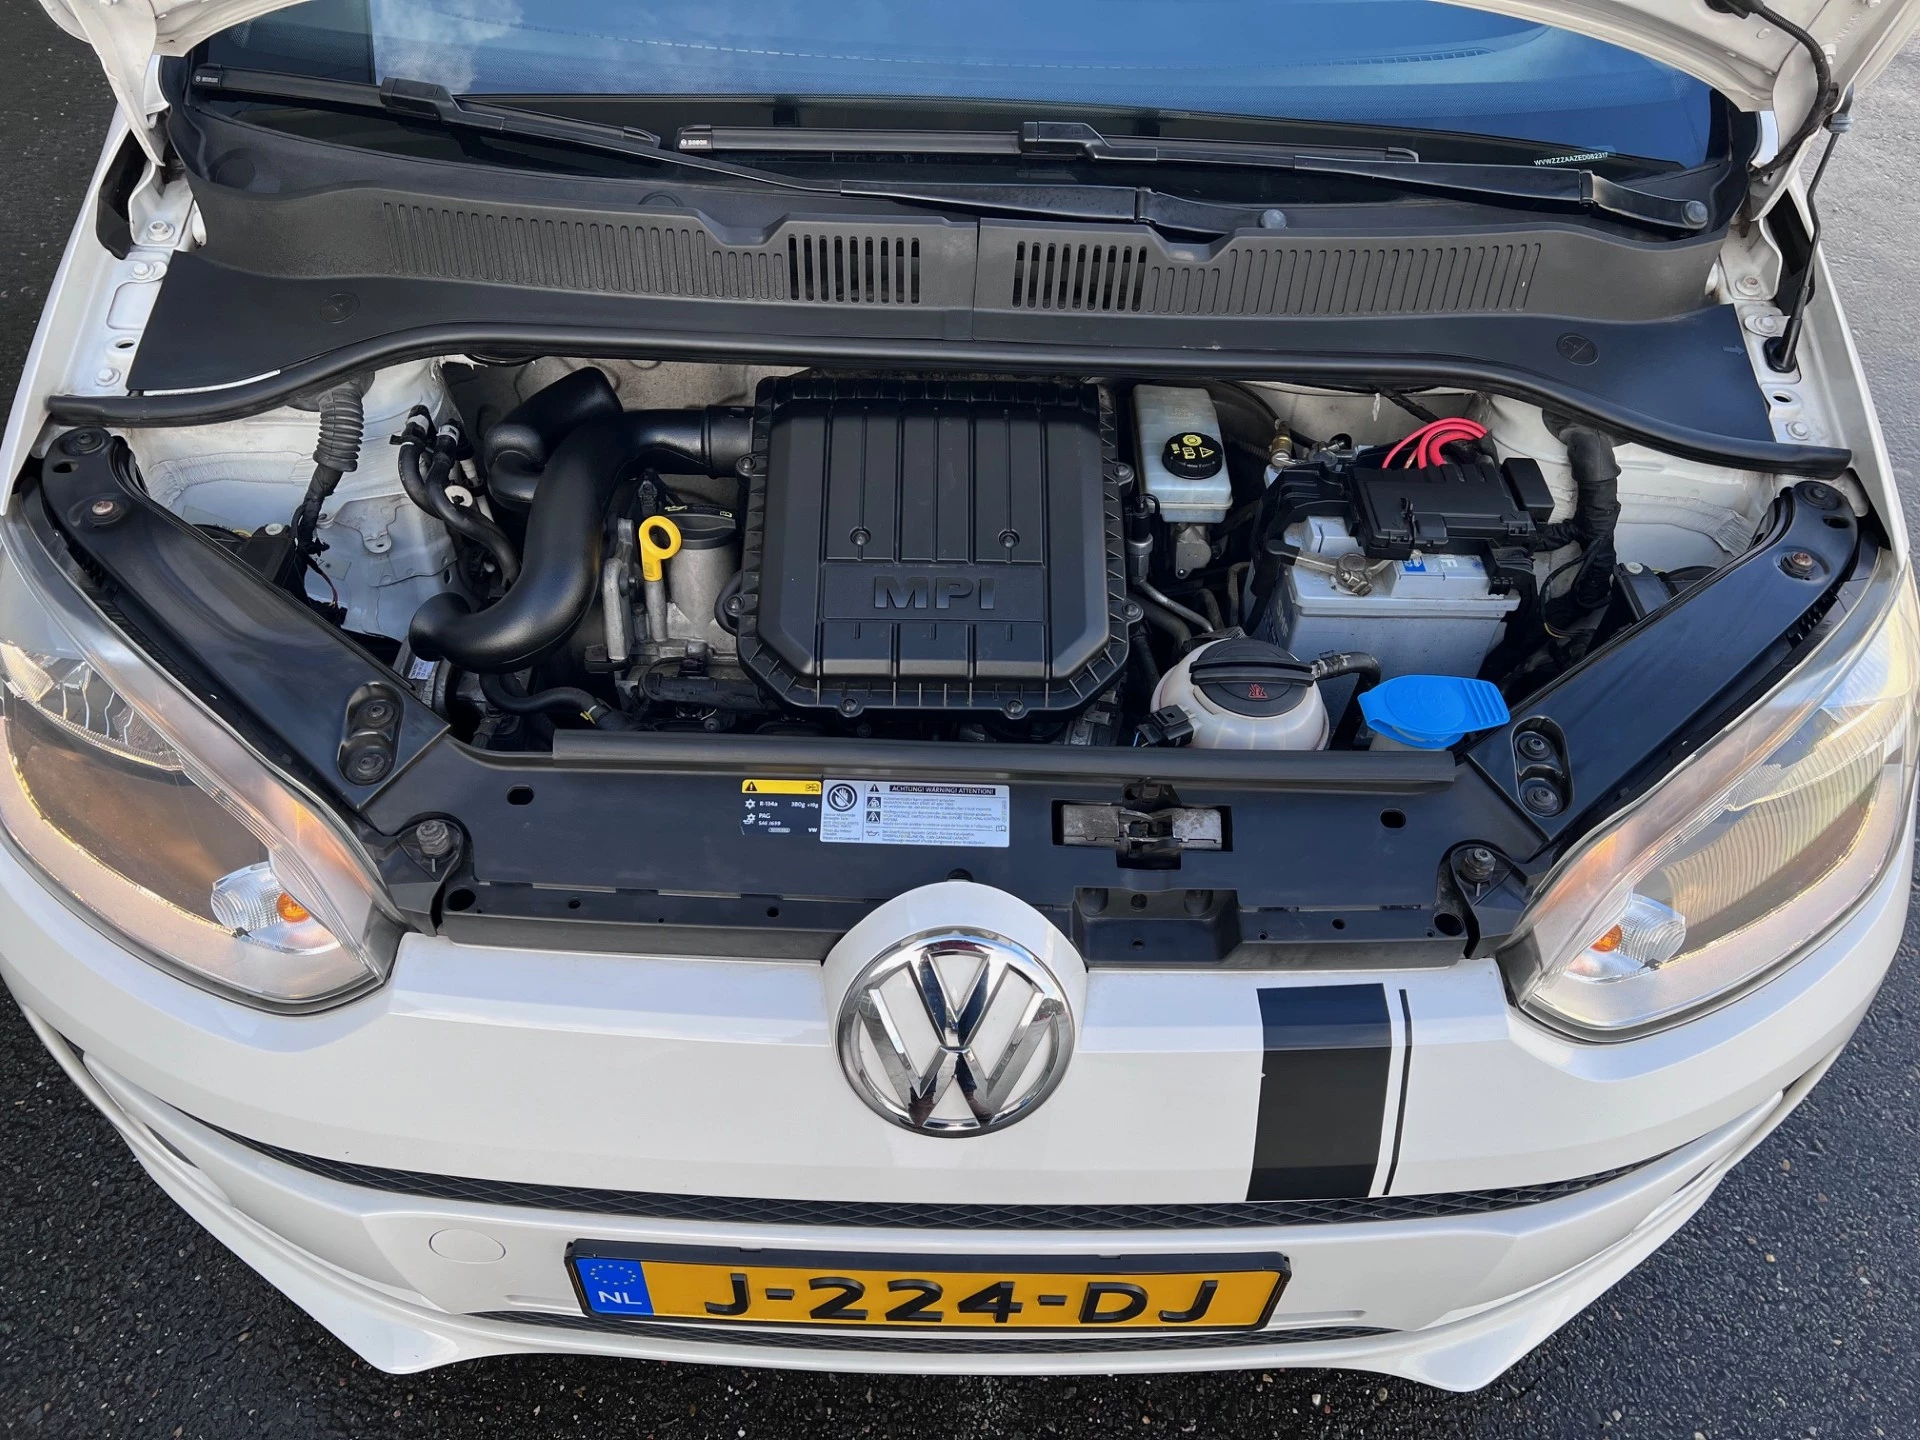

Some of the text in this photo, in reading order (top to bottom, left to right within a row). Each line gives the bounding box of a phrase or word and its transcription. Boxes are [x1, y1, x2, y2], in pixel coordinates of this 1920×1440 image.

[874, 576, 995, 610] MPI
[842, 932, 1070, 1136] VW
[598, 1290, 642, 1305] NL
[704, 1273, 1219, 1323] J-224-DJ
